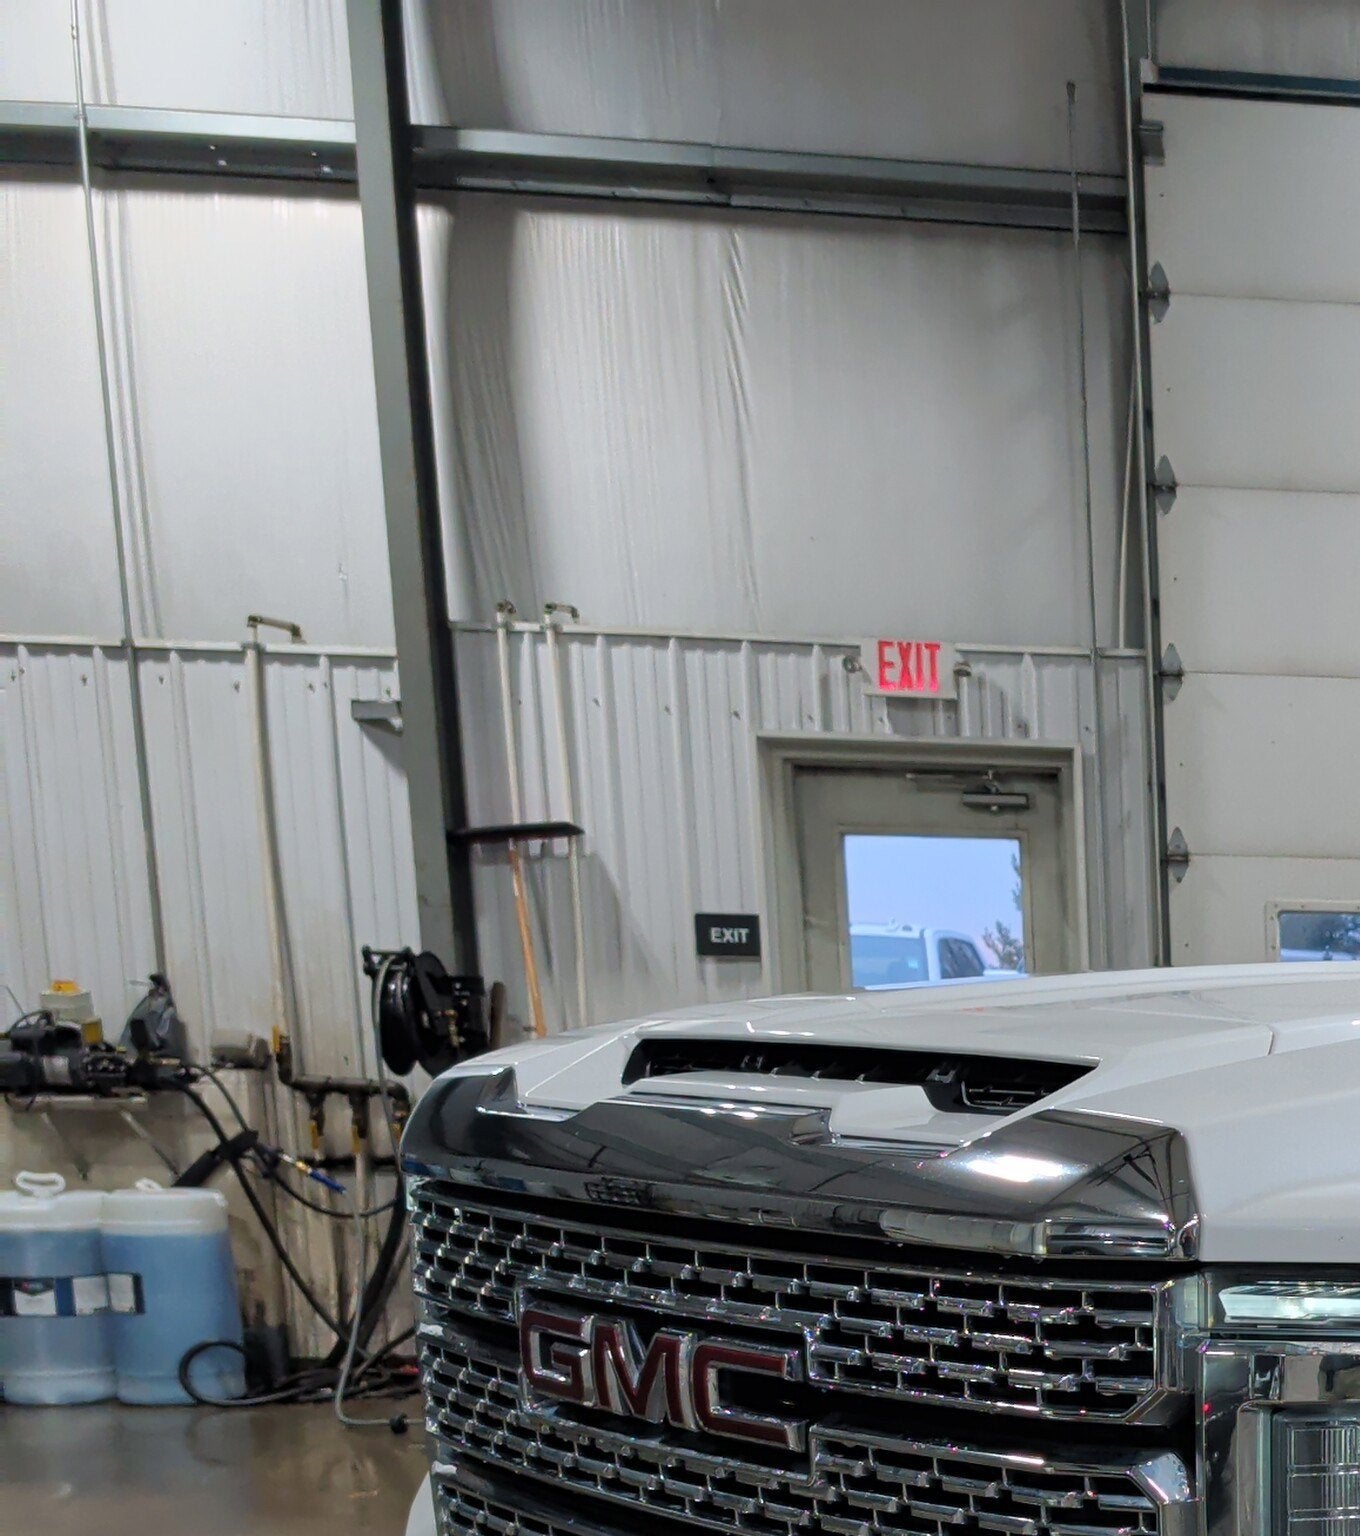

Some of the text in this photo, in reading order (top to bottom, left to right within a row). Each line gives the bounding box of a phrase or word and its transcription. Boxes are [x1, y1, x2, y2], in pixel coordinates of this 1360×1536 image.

[878, 640, 941, 692] EXIT
[710, 927, 749, 943] EXIT
[519, 1308, 808, 1451] GMC
